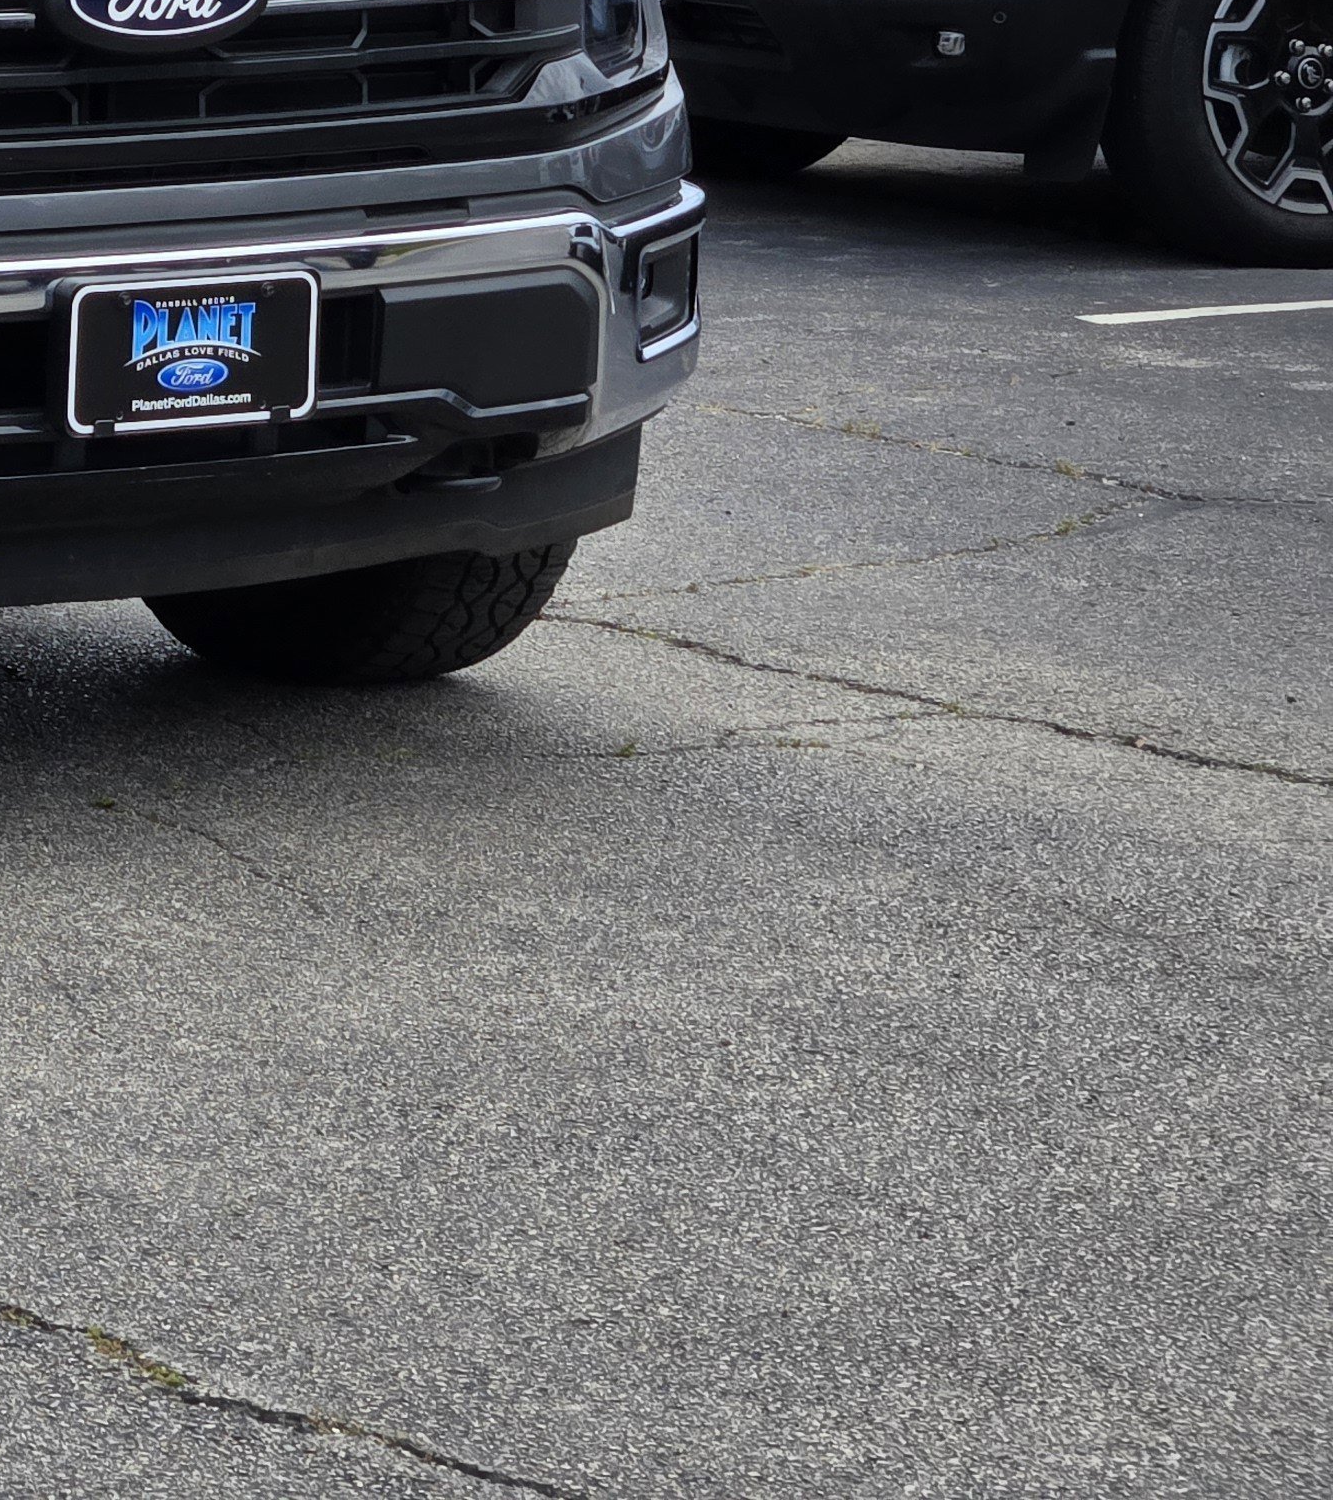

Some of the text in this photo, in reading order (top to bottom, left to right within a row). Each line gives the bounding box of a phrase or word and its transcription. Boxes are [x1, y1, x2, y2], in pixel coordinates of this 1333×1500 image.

[133, 300, 255, 360] PLANET
[136, 346, 250, 372] DALLAS LOVE FIELD
[170, 362, 214, 387] Ford
[132, 393, 251, 411] PlanetFordDallas.com
